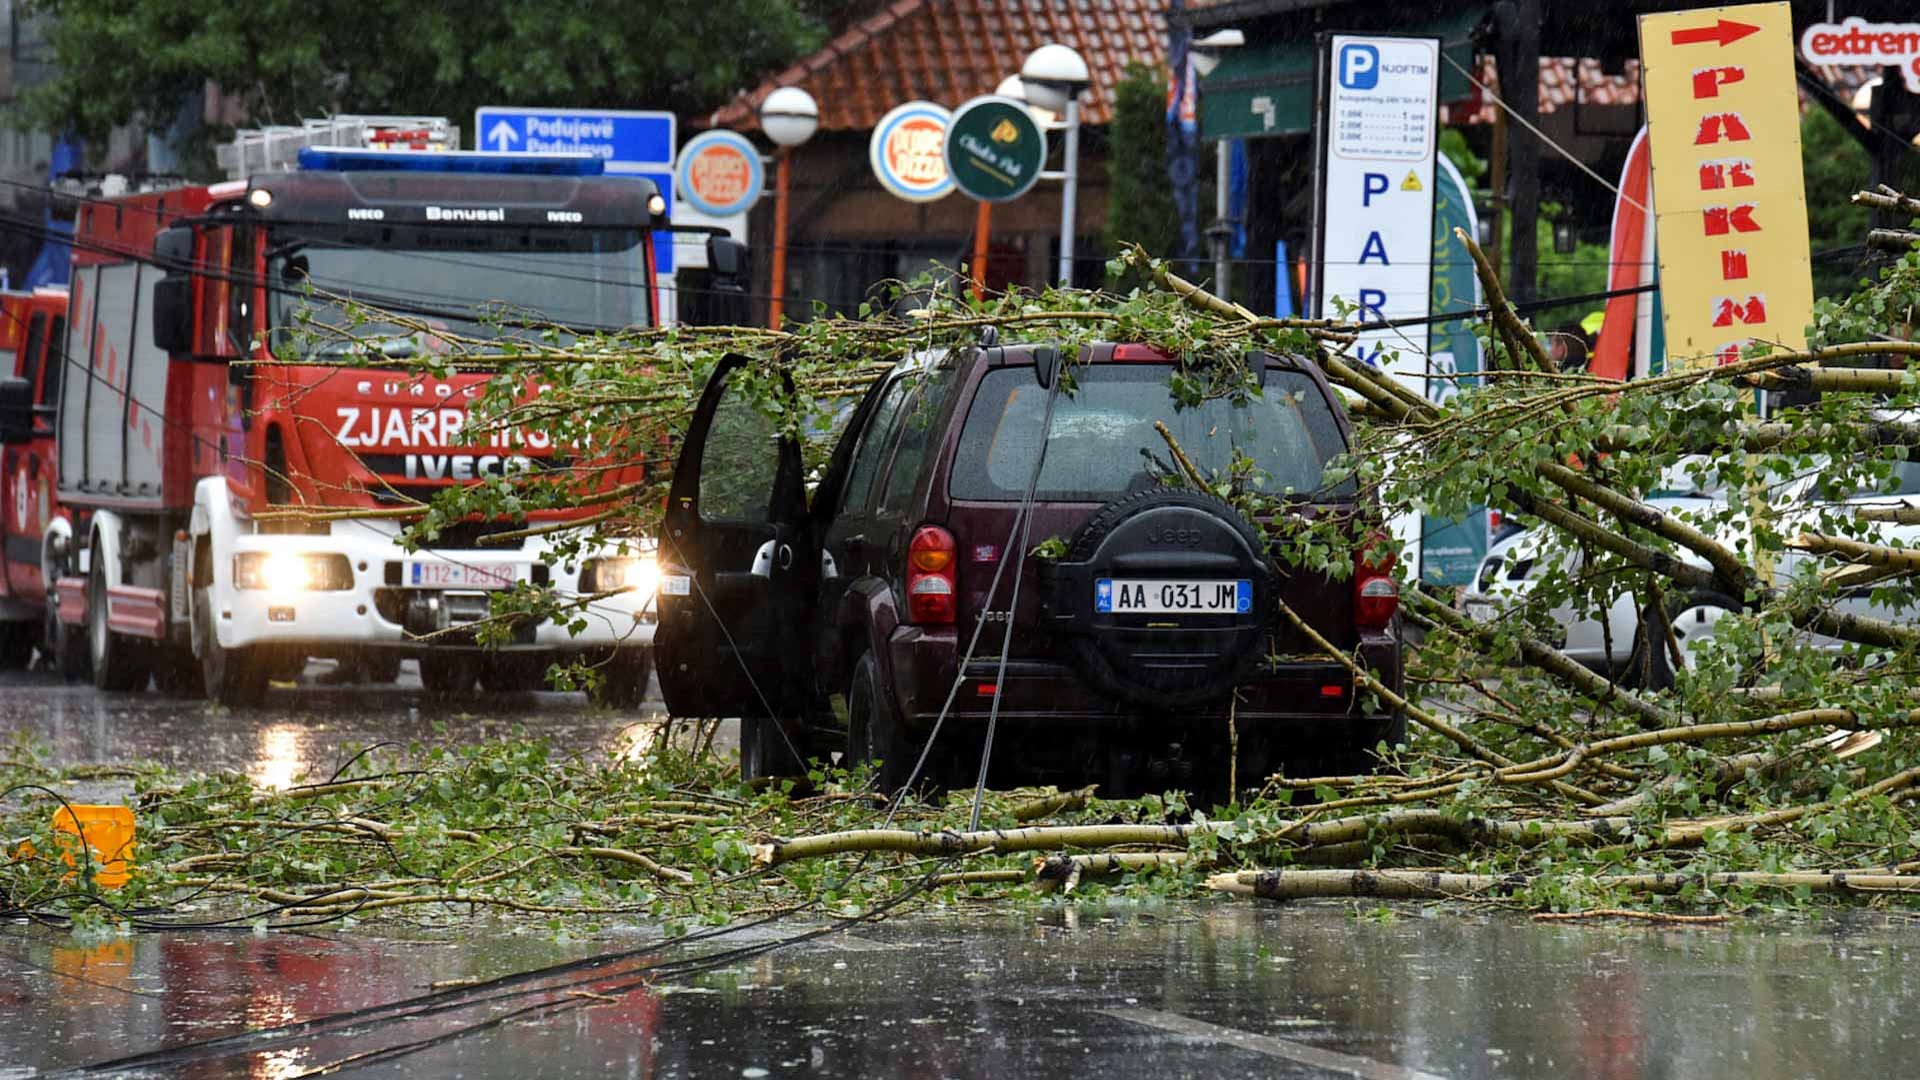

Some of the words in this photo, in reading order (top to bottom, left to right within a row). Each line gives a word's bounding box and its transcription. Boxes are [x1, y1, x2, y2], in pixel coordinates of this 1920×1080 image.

[1381, 65, 1429, 74] NJOFTIM
[348, 209, 385, 220] IVECO
[426, 206, 505, 221] Benussi
[547, 211, 583, 222] IVECO
[405, 454, 531, 480] IVECO
[1148, 524, 1202, 548] Jeep
[1118, 584, 1147, 609] AA
[1161, 584, 1203, 609] 031
[1208, 584, 1235, 609] JM
